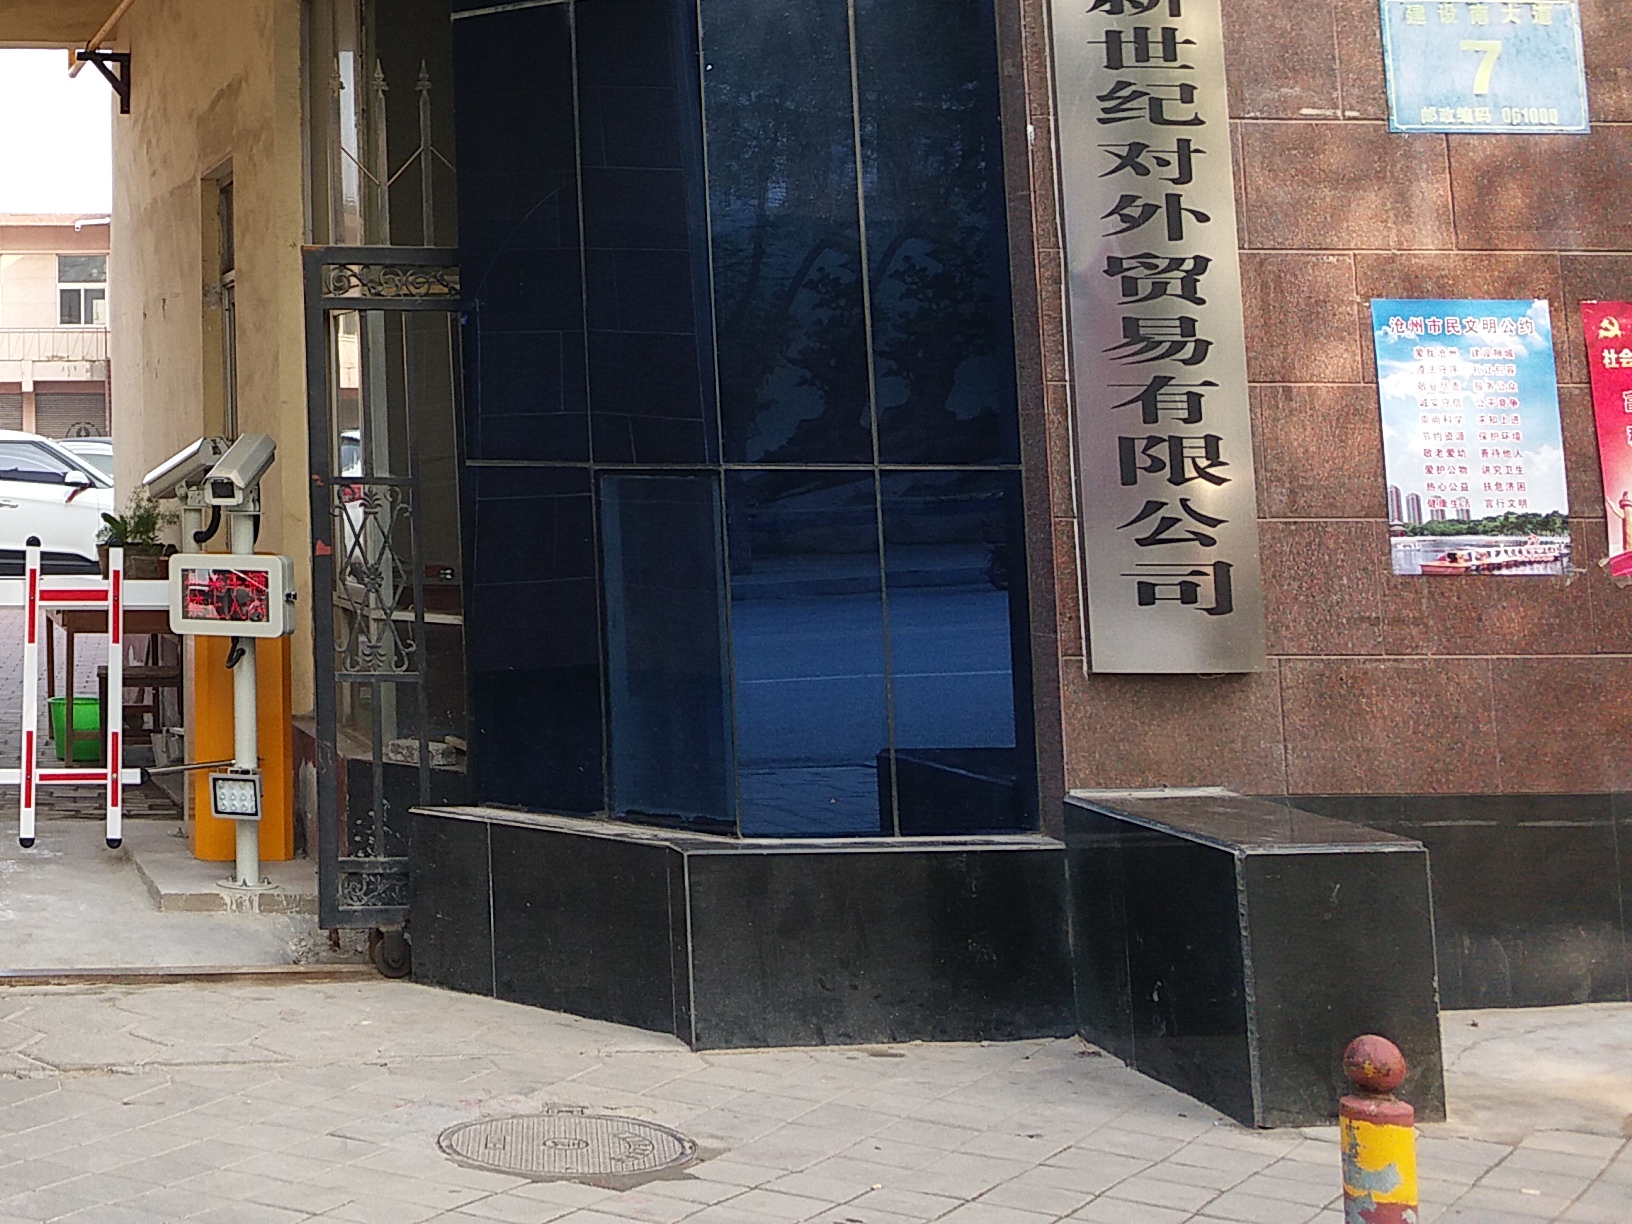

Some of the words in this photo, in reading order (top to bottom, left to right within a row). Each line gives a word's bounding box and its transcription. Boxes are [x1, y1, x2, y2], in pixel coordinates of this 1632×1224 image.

[1460, 40, 1501, 95] 7
[1420, 107, 1491, 124] 邮政编码
[1390, 317, 1534, 335] 沧州市民文明公约
[1422, 430, 1465, 442] 节约资源
[1478, 430, 1522, 442] 保护环境
[1422, 447, 1466, 459] 敬老爱幼
[1480, 447, 1523, 459] 善待他人
[1423, 464, 1468, 476] 爱护公物
[1481, 464, 1524, 476] 讲究卫生
[1425, 481, 1469, 492] 热心公益
[1482, 481, 1526, 492] 扶危济困
[1426, 498, 1471, 509] 健康生活
[1484, 498, 1528, 509] 言行文明
